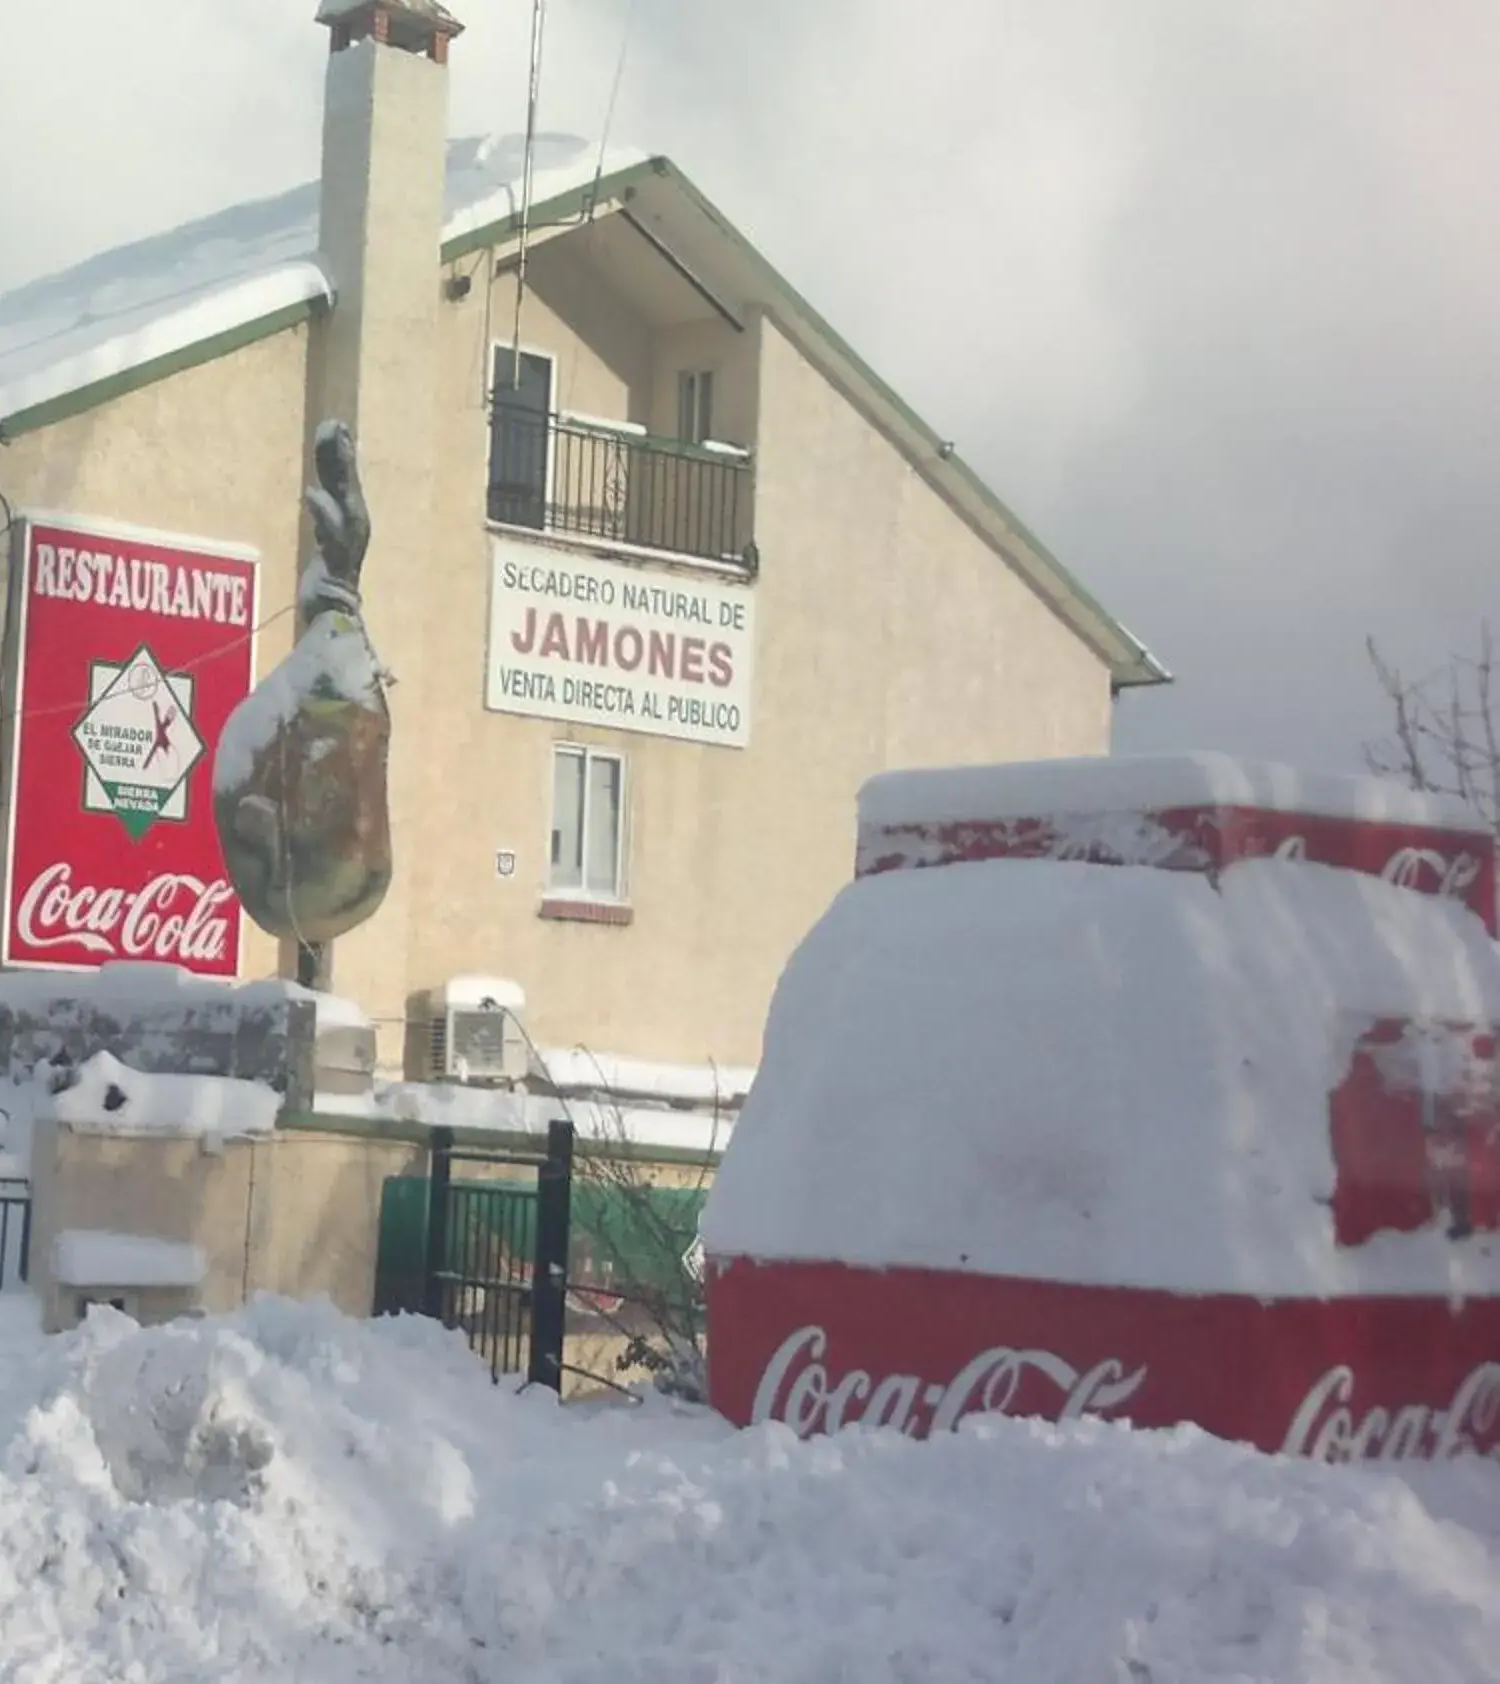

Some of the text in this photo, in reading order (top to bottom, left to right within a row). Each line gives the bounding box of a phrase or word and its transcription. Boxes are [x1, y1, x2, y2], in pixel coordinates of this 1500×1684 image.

[34, 543, 248, 625] RESTAURANTE
[502, 562, 745, 630] SECADERO NATURAL DE
[510, 607, 734, 687] JAMONES
[83, 722, 153, 741] EL MIRADOR
[500, 666, 740, 732] VENTA DIRECTA AL PUBLICO
[88, 738, 102, 750] DE
[100, 753, 136, 768] SIERRA
[113, 797, 160, 812] NEVADA
[117, 785, 159, 800] SIERRA
[17, 861, 235, 960] Coca-Cola
[751, 1324, 1148, 1440] Coca-Cl
